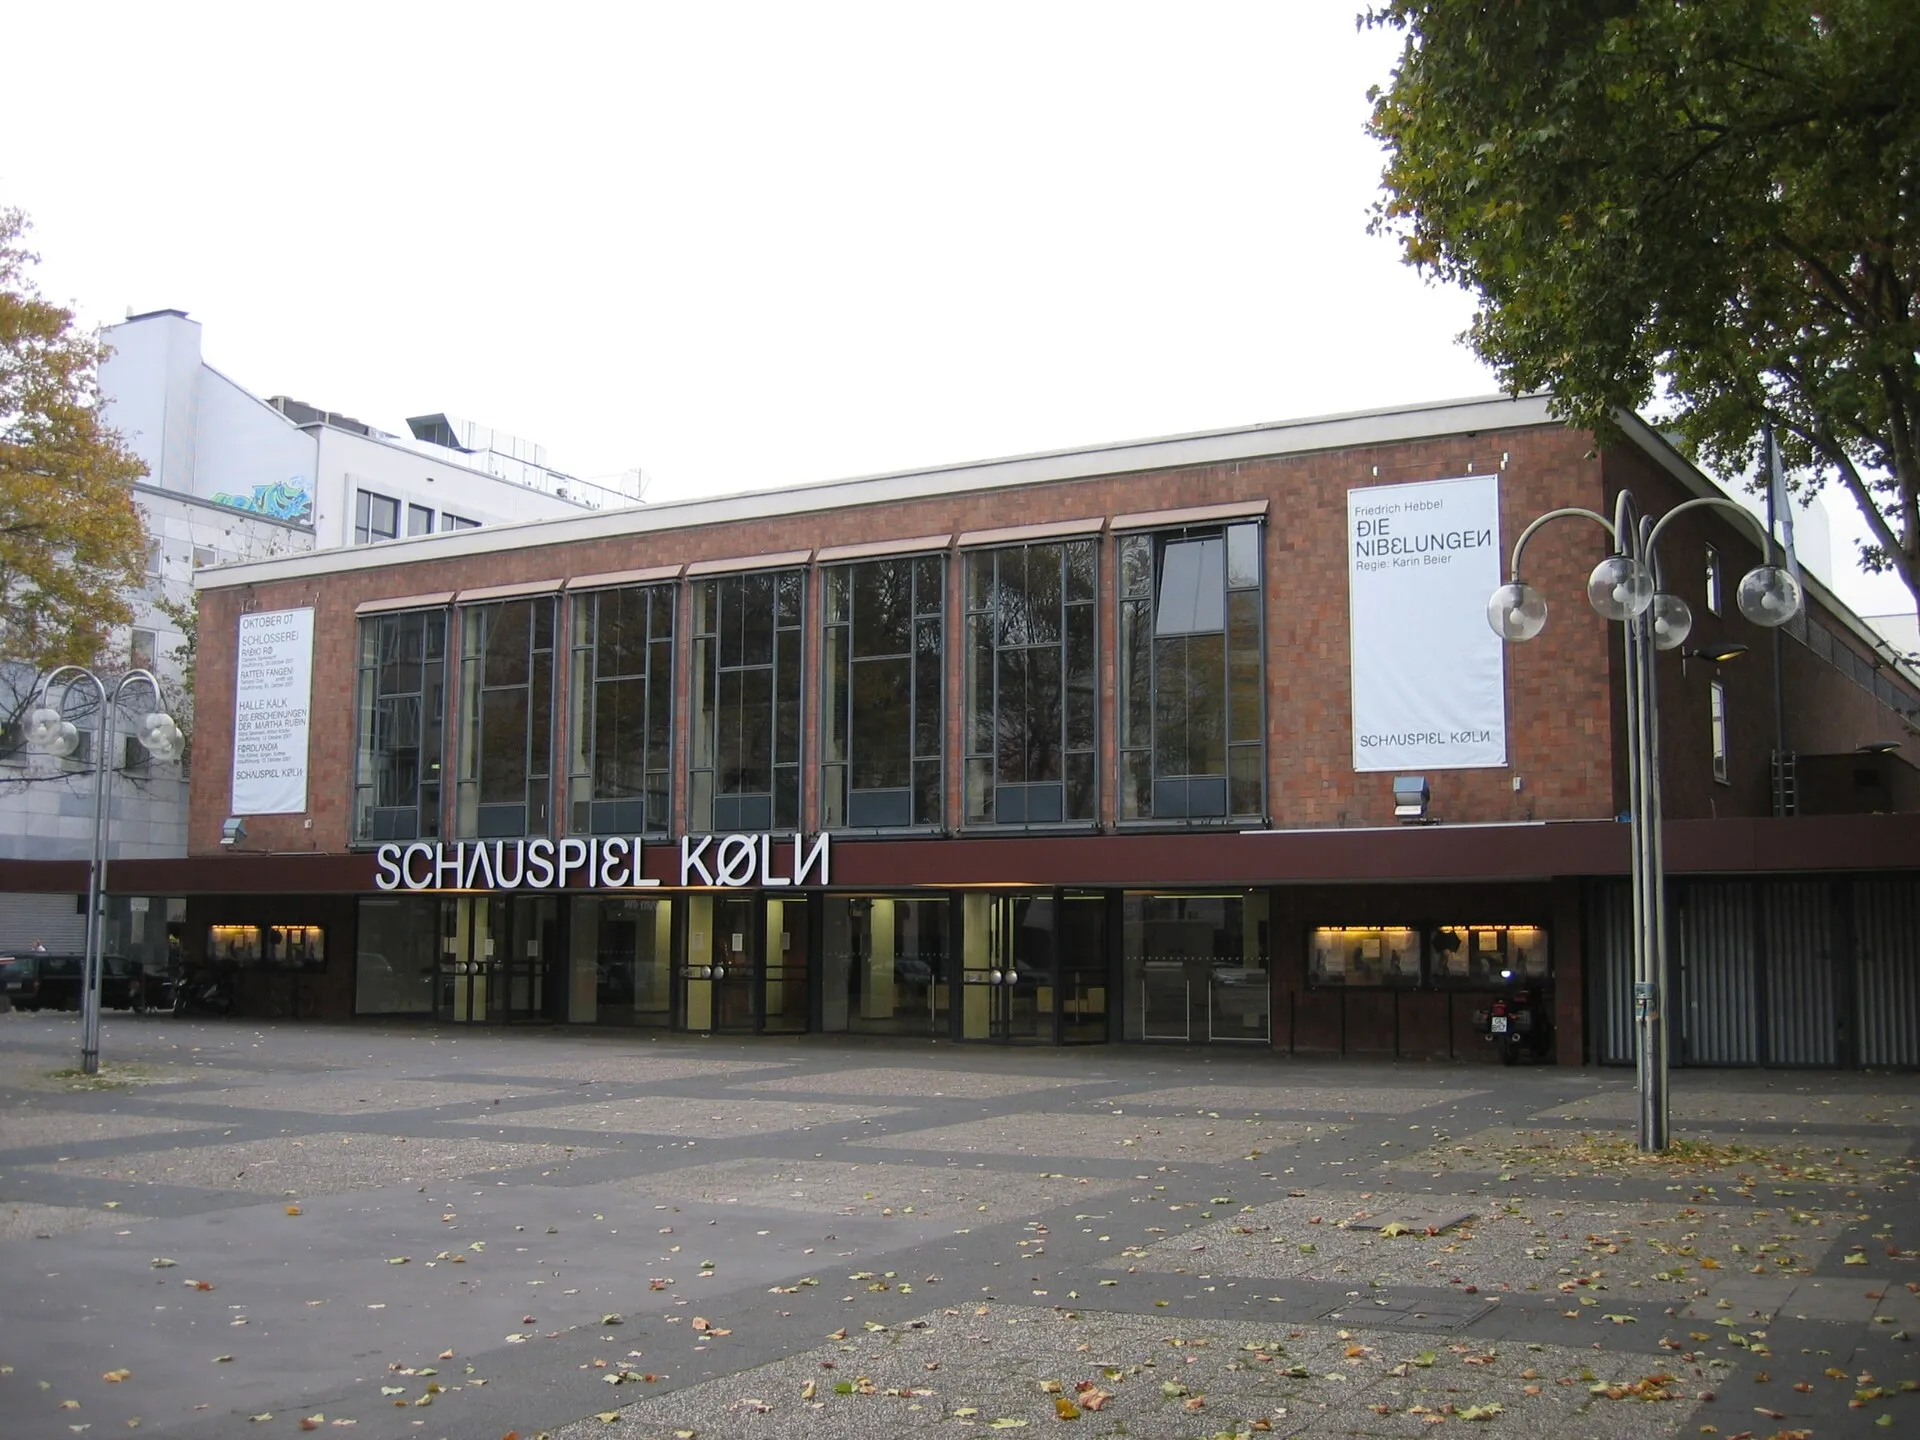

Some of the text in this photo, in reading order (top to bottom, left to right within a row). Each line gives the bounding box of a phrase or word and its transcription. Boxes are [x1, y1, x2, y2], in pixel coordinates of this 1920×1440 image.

[1354, 499, 1443, 517] Friedrich Hebbel
[1356, 554, 1452, 572] Regie: Karin Beier
[243, 615, 293, 629] OKTOBER 07
[242, 631, 298, 646] SCHLOSSEREI
[239, 698, 287, 710] HALLE KALK
